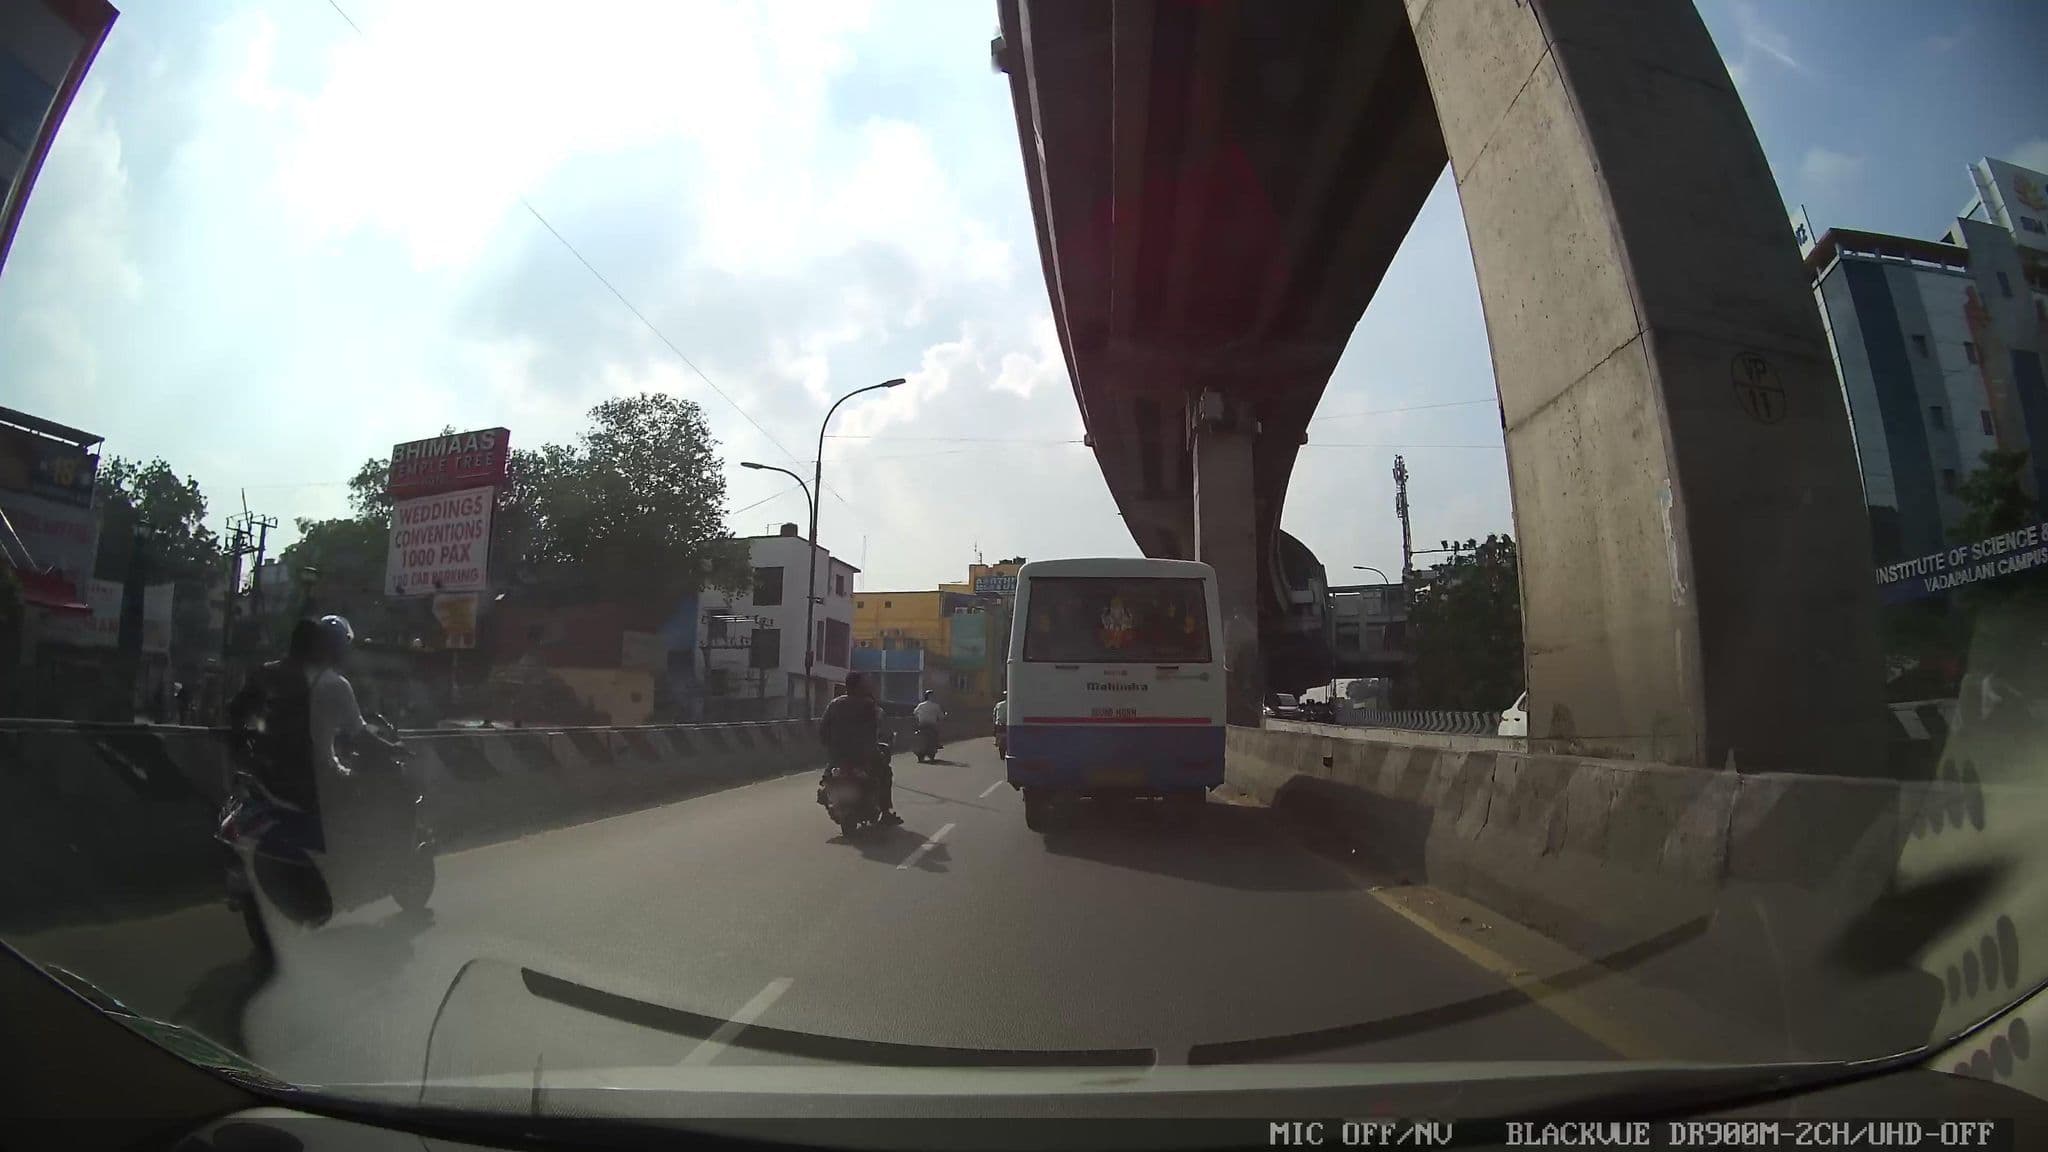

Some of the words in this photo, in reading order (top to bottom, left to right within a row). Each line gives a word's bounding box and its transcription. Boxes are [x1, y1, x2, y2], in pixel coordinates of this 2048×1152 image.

[393, 430, 496, 463] BHIMAAS
[456, 452, 493, 470] TREE
[399, 496, 483, 526] WEDDINGS
[395, 520, 483, 549] CONVENTIONS
[402, 547, 436, 569] 1000
[440, 543, 472, 566] PAX
[1875, 553, 1946, 585] INSTITUTE
[1948, 546, 1969, 567] OF
[1970, 525, 2039, 561] SCIENCE
[1924, 562, 1996, 592] VADAPALANI
[1998, 547, 2048, 575] CAMPUS
